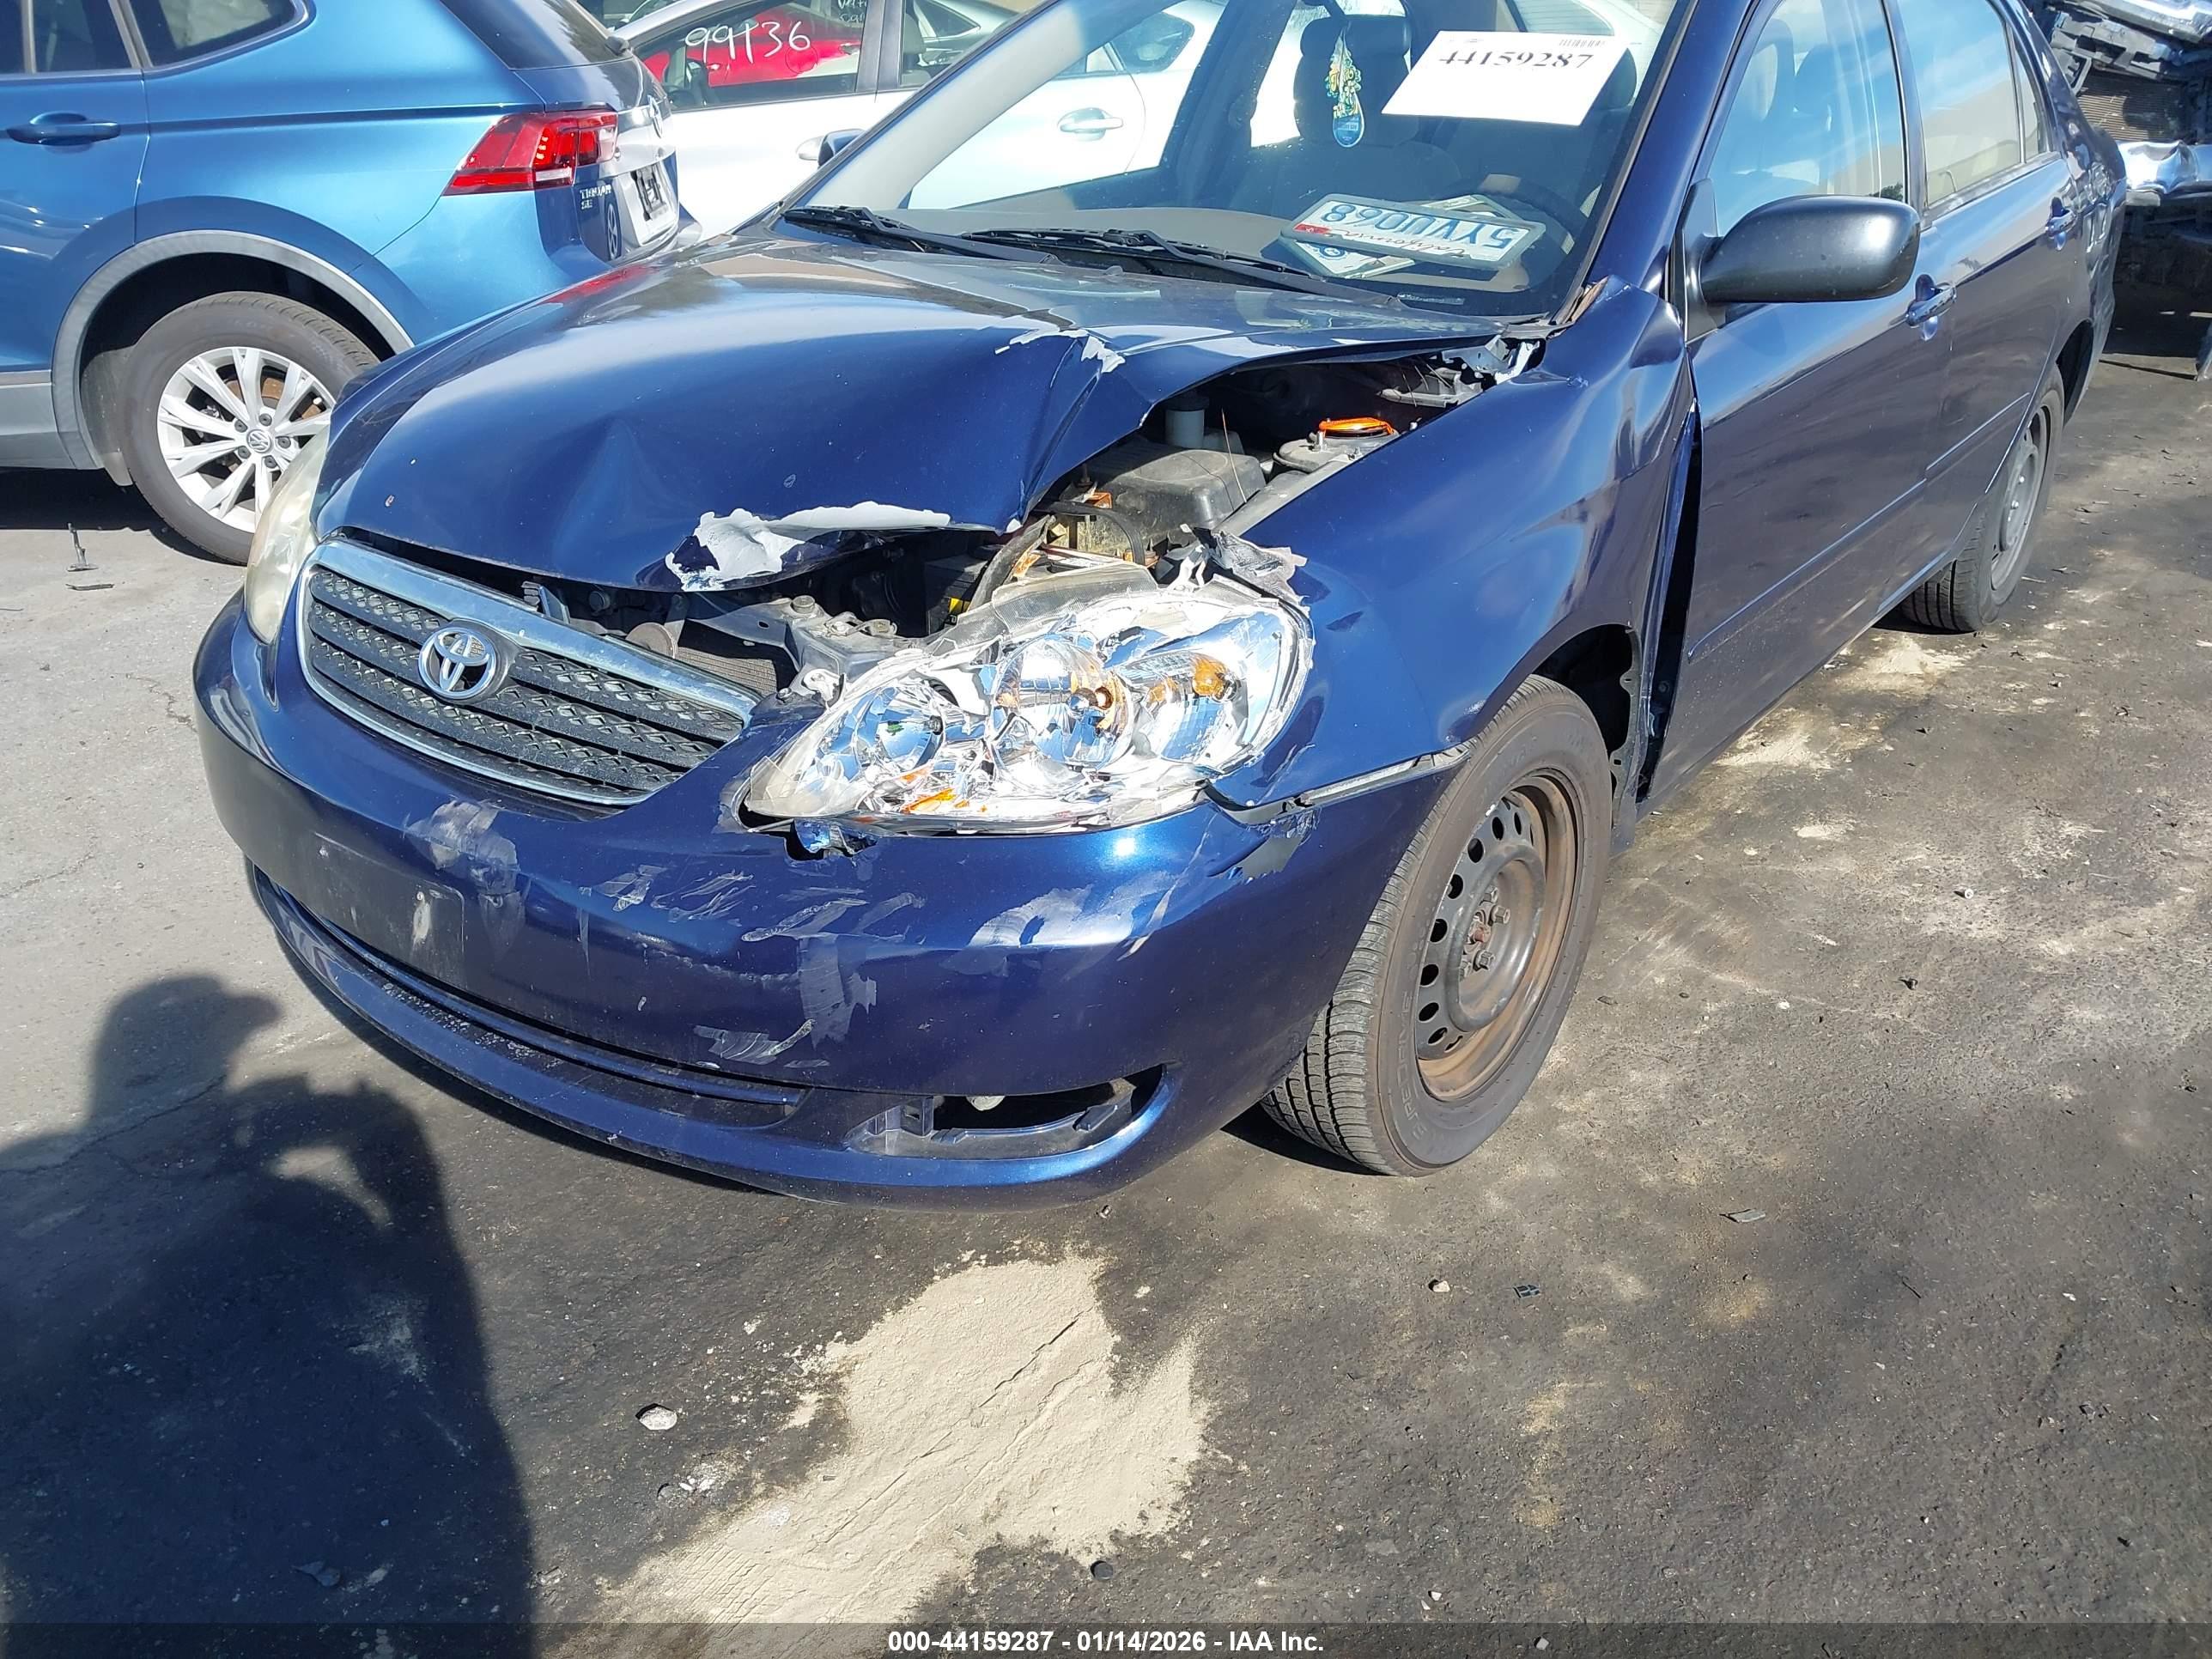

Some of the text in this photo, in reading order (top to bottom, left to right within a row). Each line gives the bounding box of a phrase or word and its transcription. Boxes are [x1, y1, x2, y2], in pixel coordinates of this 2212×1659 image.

[684, 21, 811, 64] 99136
[1438, 50, 1595, 69] 44159287
[1322, 204, 1522, 249] 5YVU068
